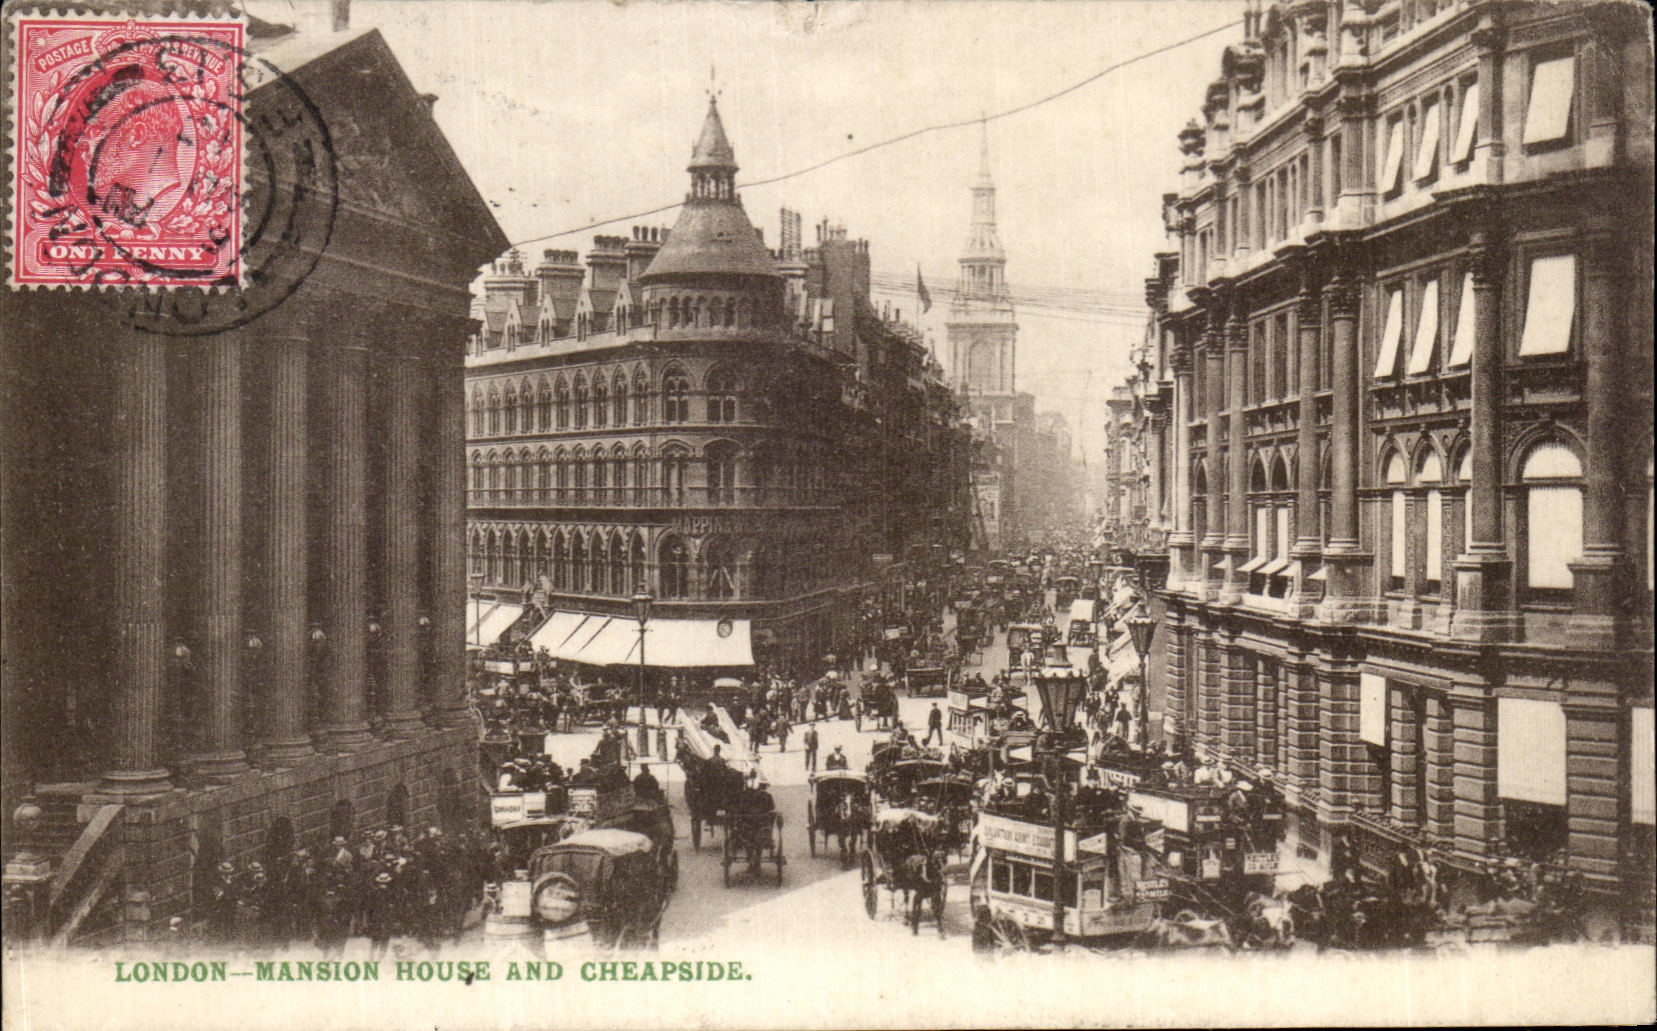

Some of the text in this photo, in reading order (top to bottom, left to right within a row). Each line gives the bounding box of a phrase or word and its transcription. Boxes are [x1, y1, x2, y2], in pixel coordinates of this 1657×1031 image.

[37, 39, 90, 72] POSTAGE
[50, 245, 204, 261] ONE PENNY
